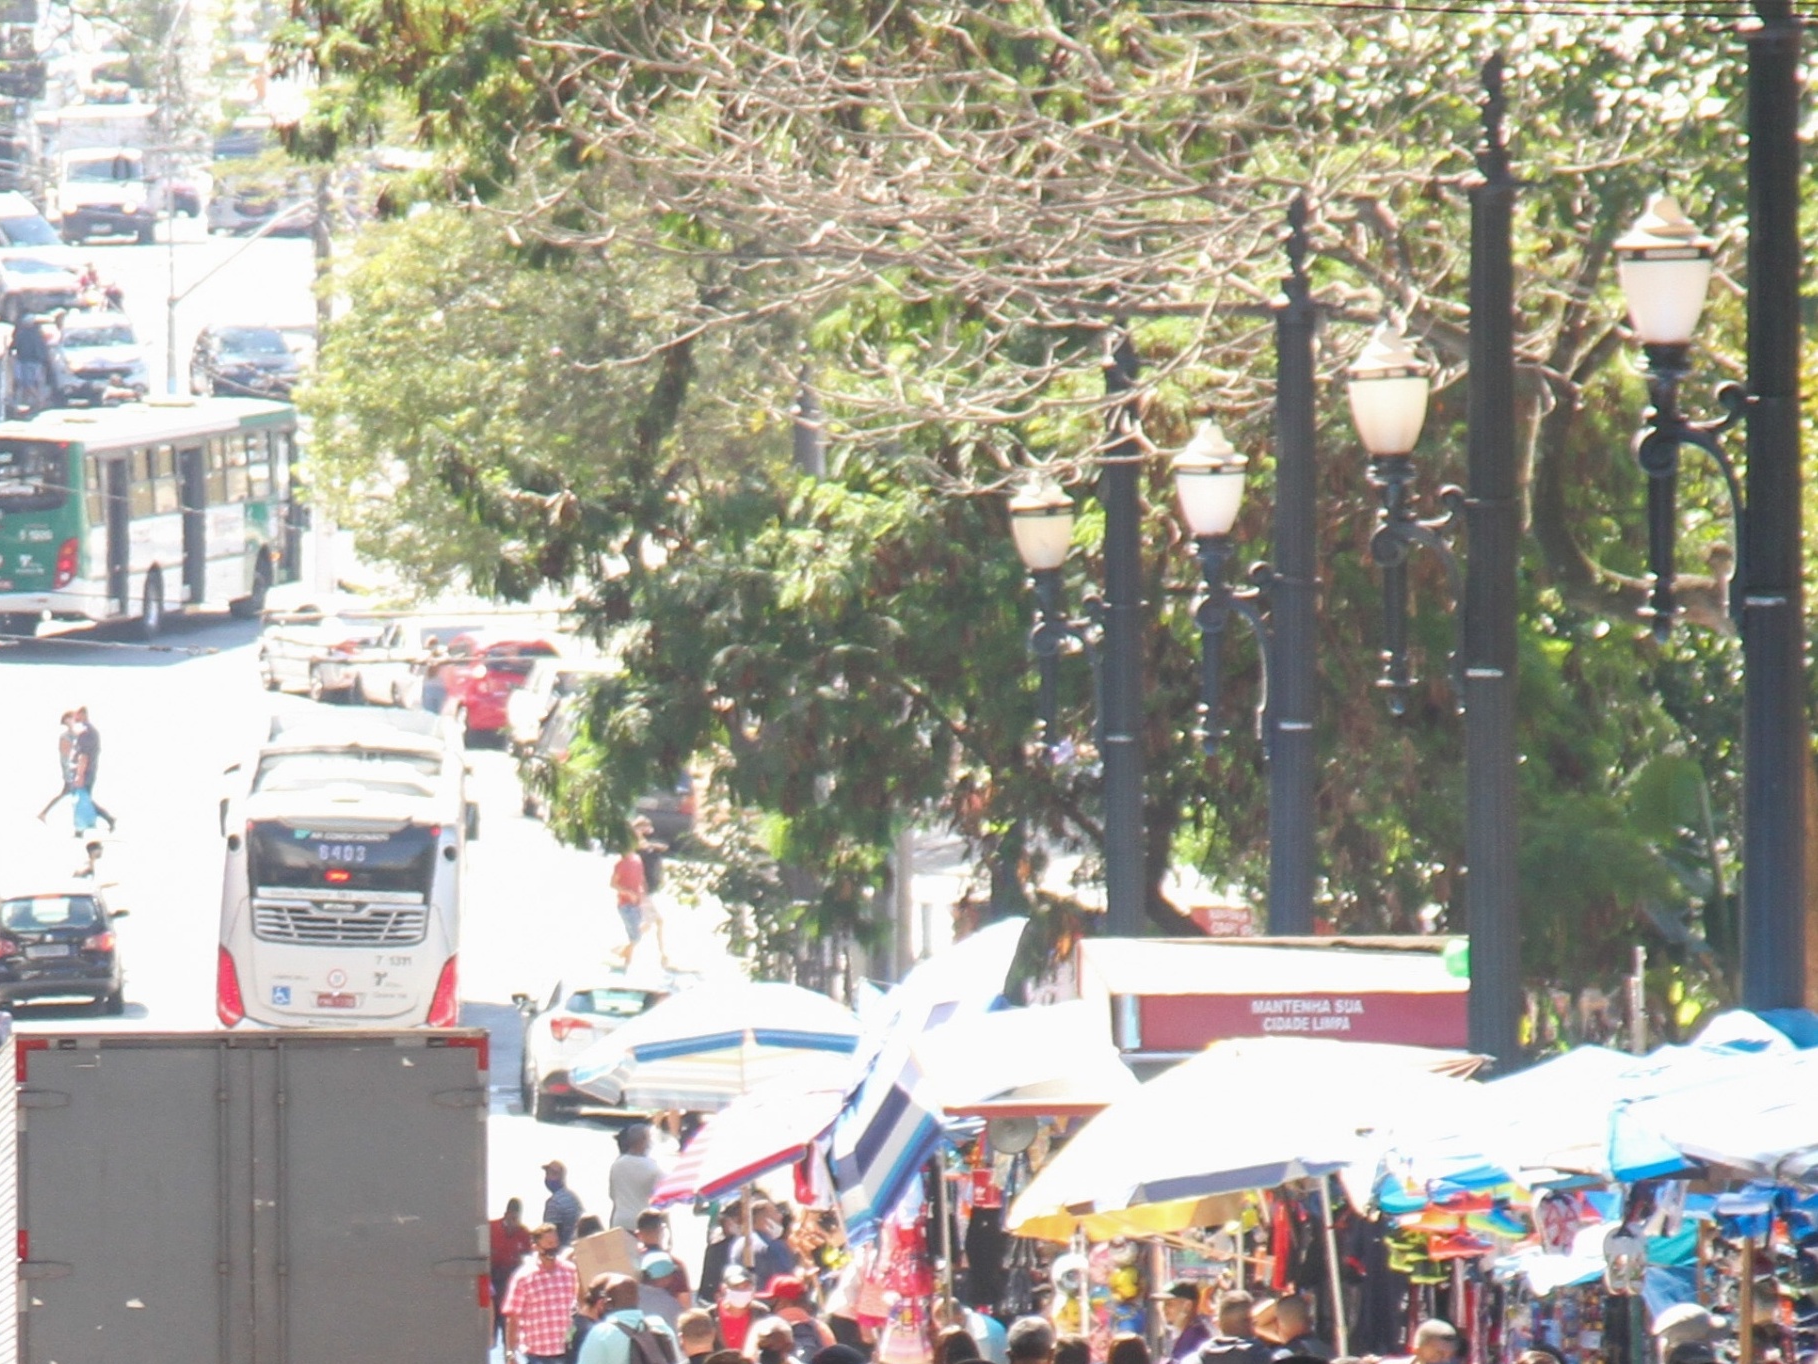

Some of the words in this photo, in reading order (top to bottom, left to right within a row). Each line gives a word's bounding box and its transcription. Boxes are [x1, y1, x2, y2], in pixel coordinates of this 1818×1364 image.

[1251, 999, 1331, 1014] MANTENHA
[1334, 999, 1364, 1014] SUA
[1263, 1016, 1310, 1031] CIDADE
[1311, 1016, 1351, 1031] LIMPA
